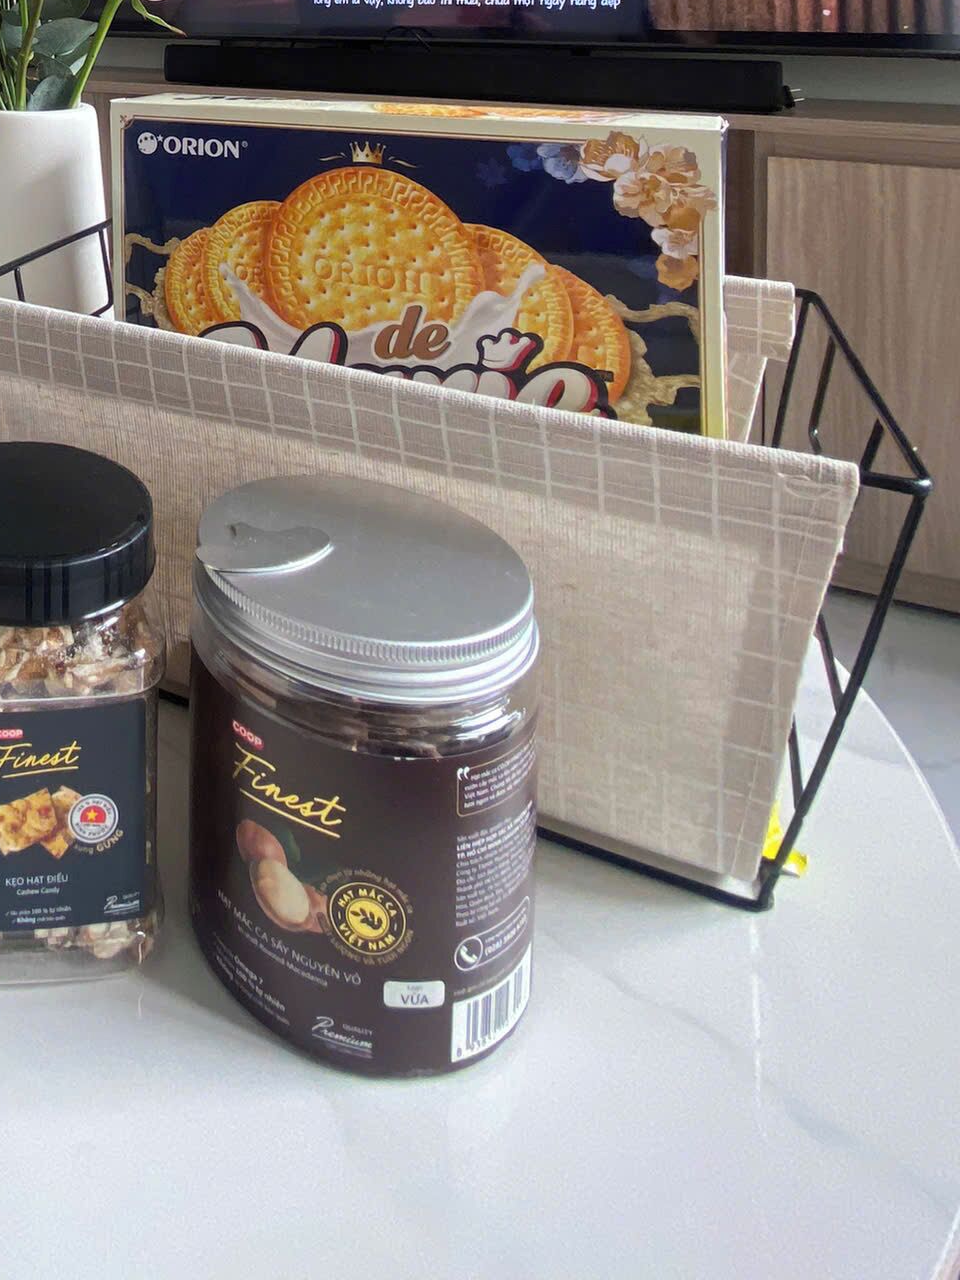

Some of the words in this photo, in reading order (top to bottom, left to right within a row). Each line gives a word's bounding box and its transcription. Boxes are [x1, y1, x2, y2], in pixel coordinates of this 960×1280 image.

[163, 136, 239, 158] ORION
[373, 304, 452, 361] de
[233, 720, 262, 746] COOP
[233, 742, 346, 825] Finest
[385, 902, 397, 917] CA
[254, 925, 269, 943] CA
[291, 949, 341, 980] NGUYÊN
[368, 933, 396, 951] NAM
[312, 1016, 372, 1048] Premium
